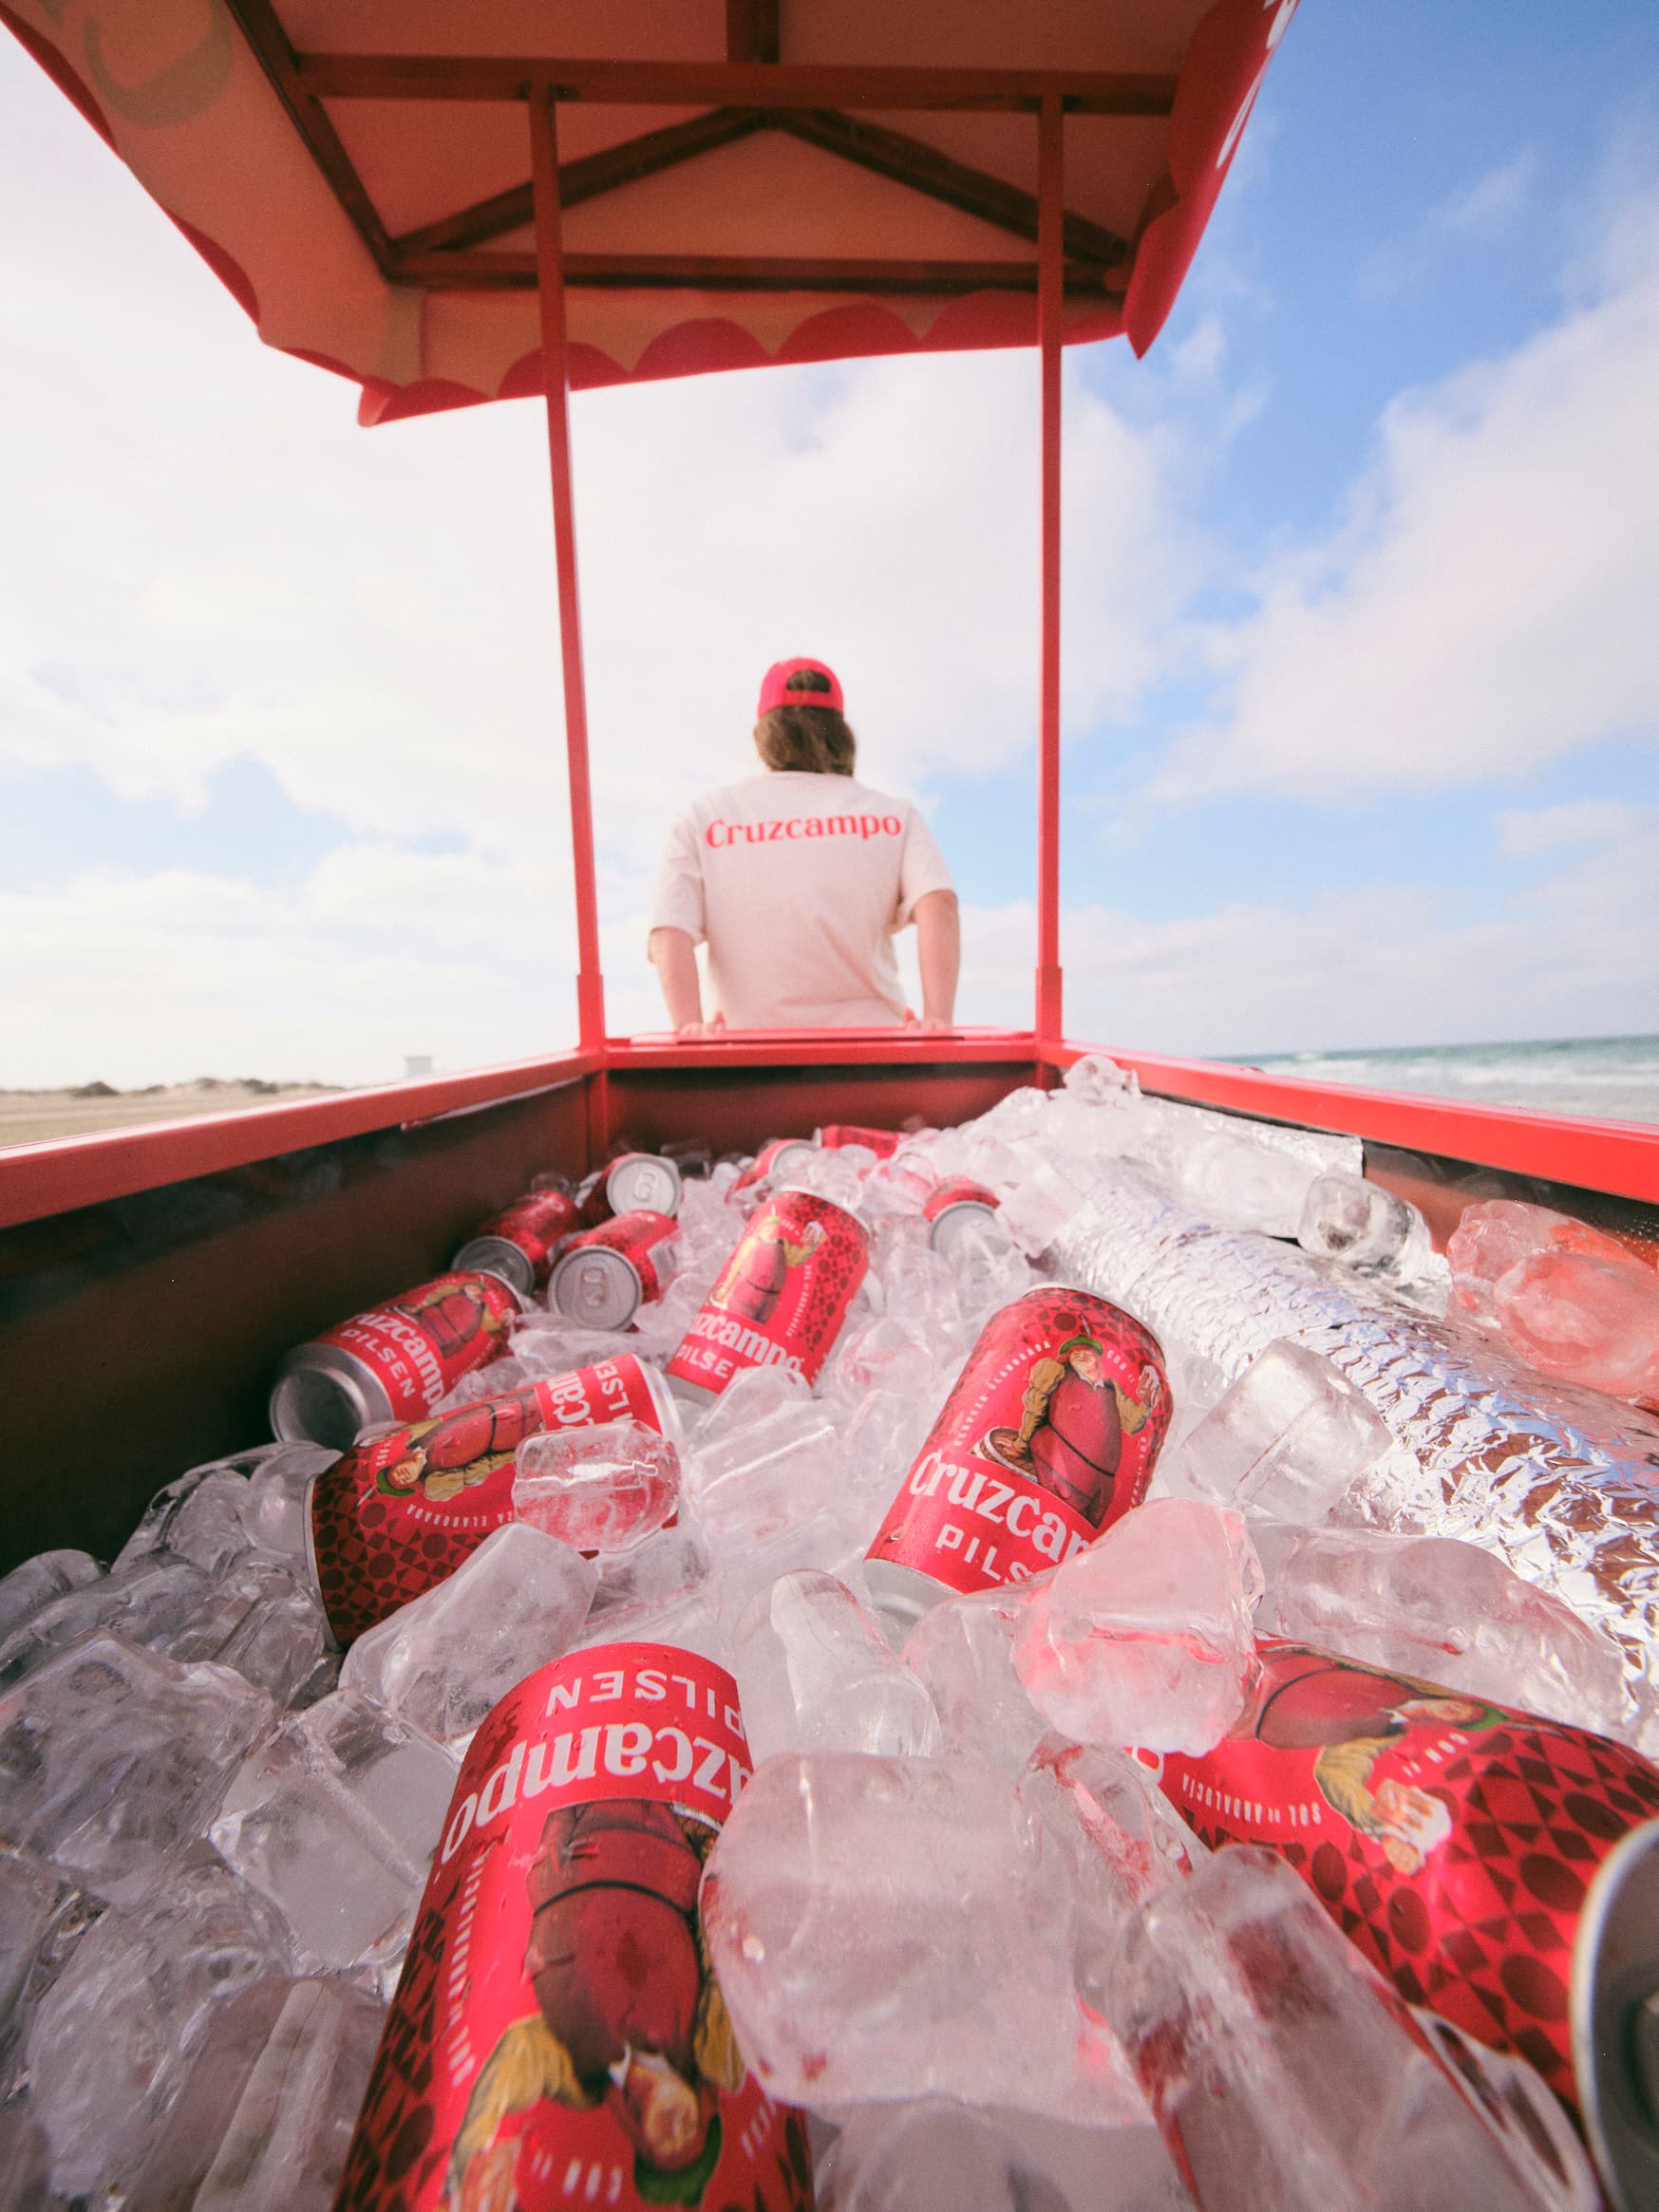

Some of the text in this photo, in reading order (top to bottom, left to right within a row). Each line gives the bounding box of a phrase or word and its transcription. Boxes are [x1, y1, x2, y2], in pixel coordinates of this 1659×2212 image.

[706, 814, 902, 849] Cruzcampo
[341, 1329, 416, 1398] PILSEN
[1288, 1802, 1322, 1828] SOL
